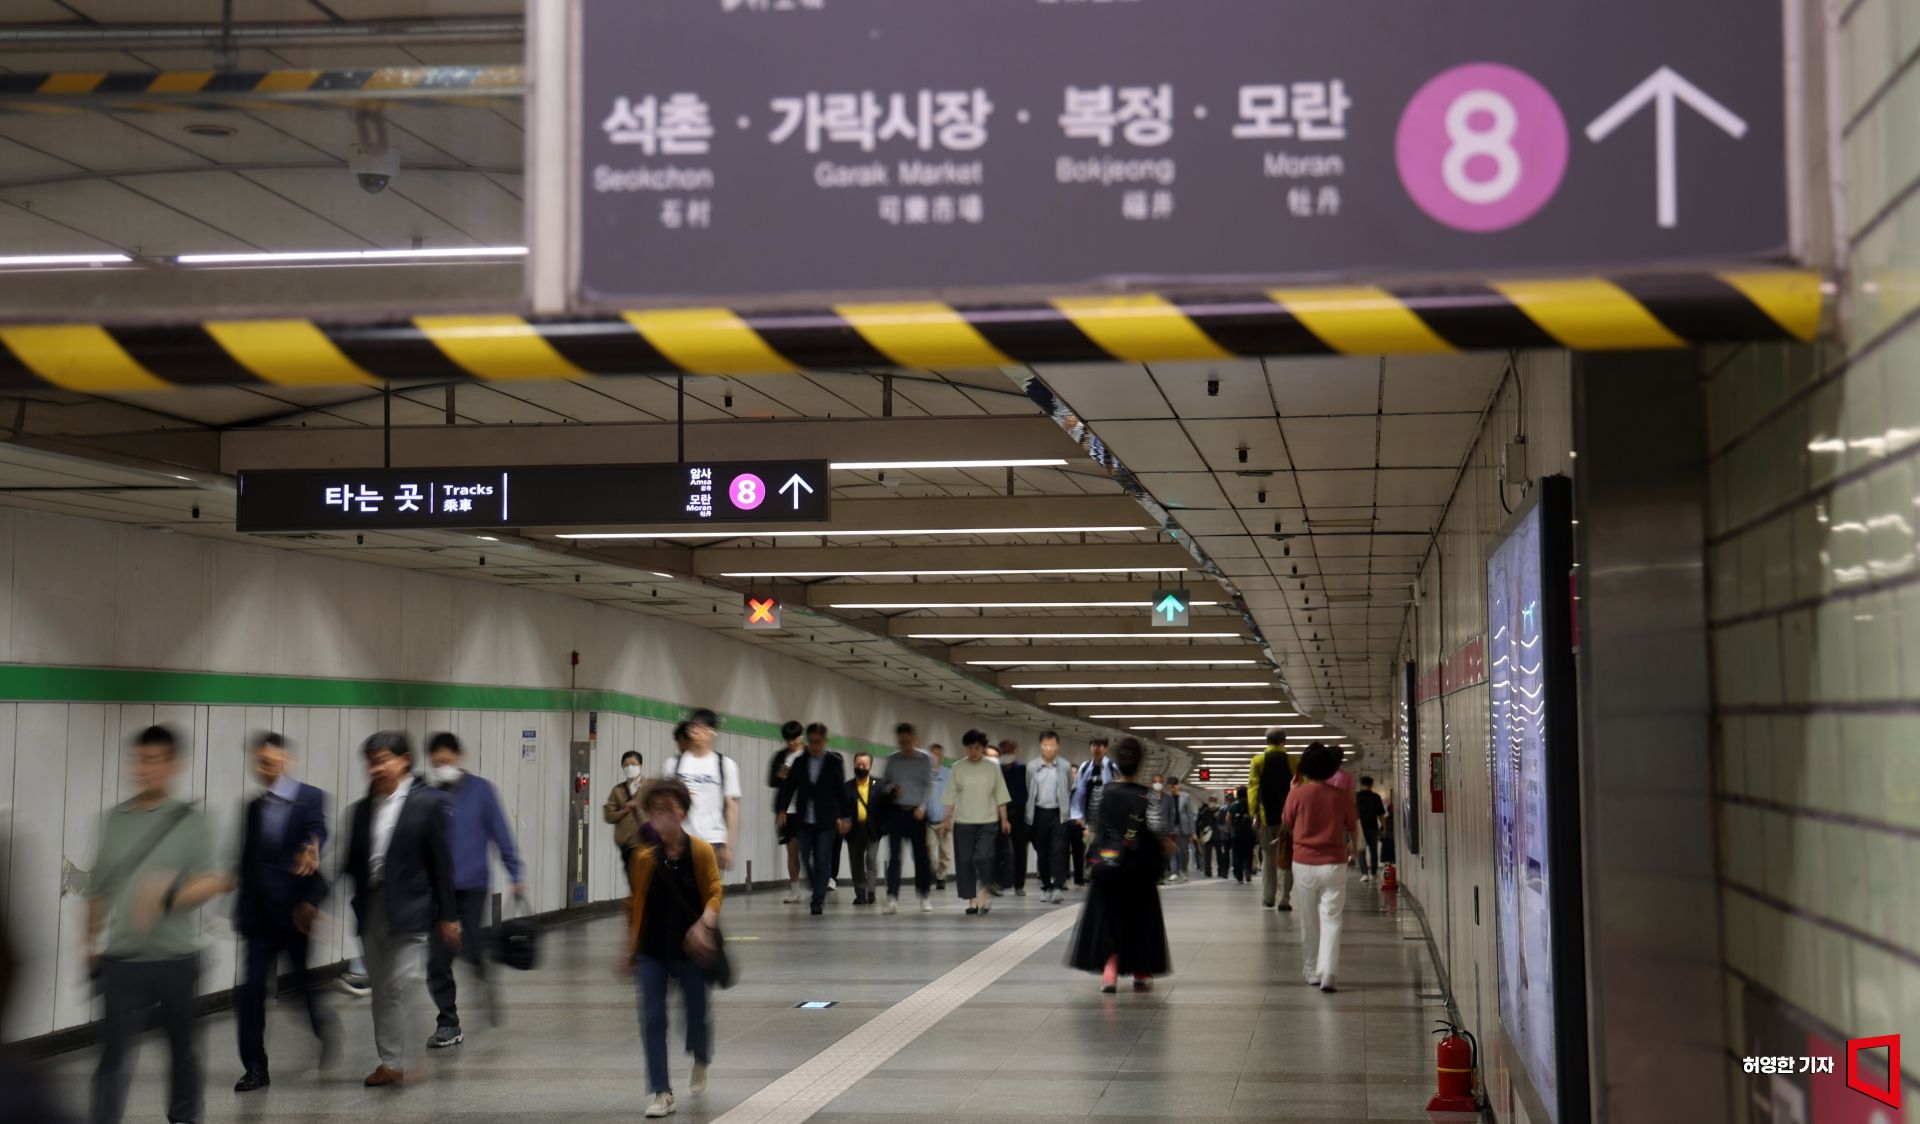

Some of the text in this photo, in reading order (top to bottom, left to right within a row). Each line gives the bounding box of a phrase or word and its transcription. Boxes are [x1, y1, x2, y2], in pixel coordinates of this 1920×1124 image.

[602, 78, 1352, 155] 석촌 가락시장 복정 모란
[1442, 89, 1522, 203] 8
[594, 150, 1344, 192] Seokchon Garak Market Bokjeong Moran
[690, 468, 712, 479] 암사
[325, 484, 424, 512] 타는 곳
[443, 484, 494, 496] Tracks
[690, 494, 711, 505] 모란
[737, 479, 757, 504] 8
